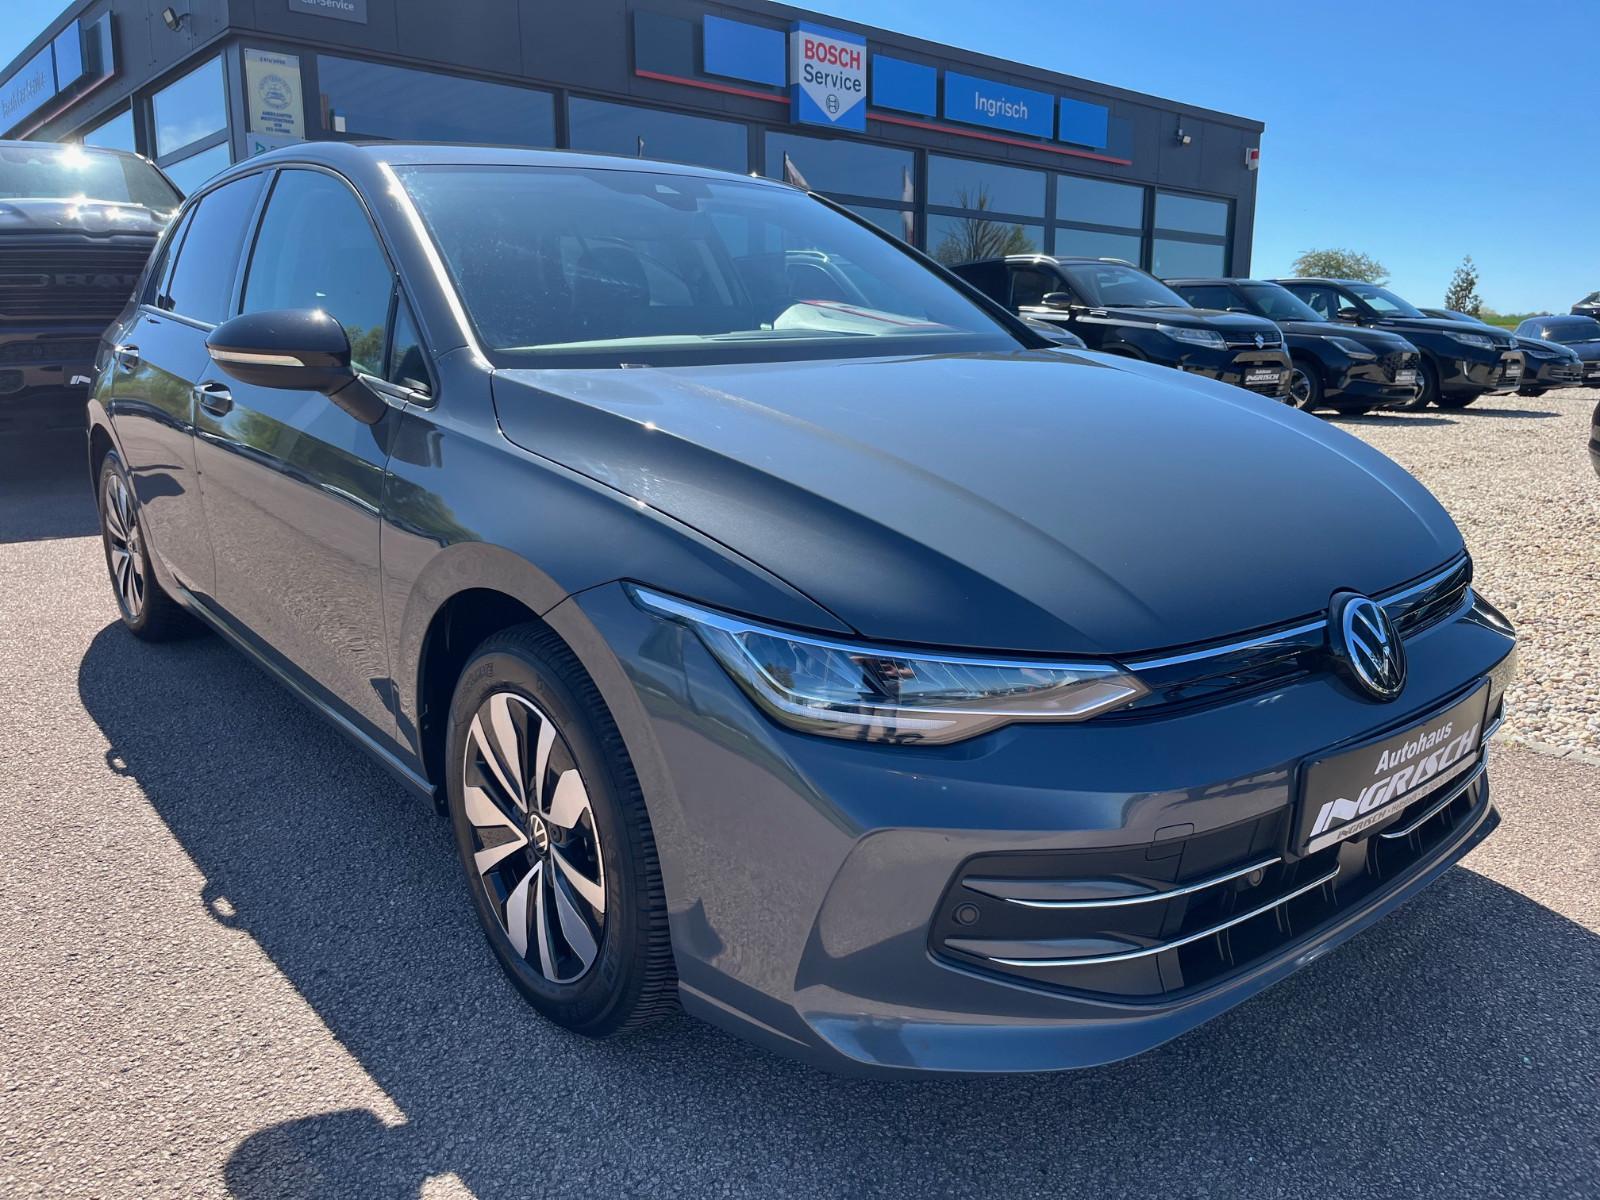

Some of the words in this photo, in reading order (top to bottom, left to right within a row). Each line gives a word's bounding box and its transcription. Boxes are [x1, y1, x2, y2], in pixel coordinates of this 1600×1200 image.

[804, 39, 861, 70] BOSCH
[803, 63, 862, 92] Service
[975, 91, 1028, 120] Ingrisch
[1374, 722, 1453, 775] Autohaus
[1310, 723, 1479, 837] INGRISCH
